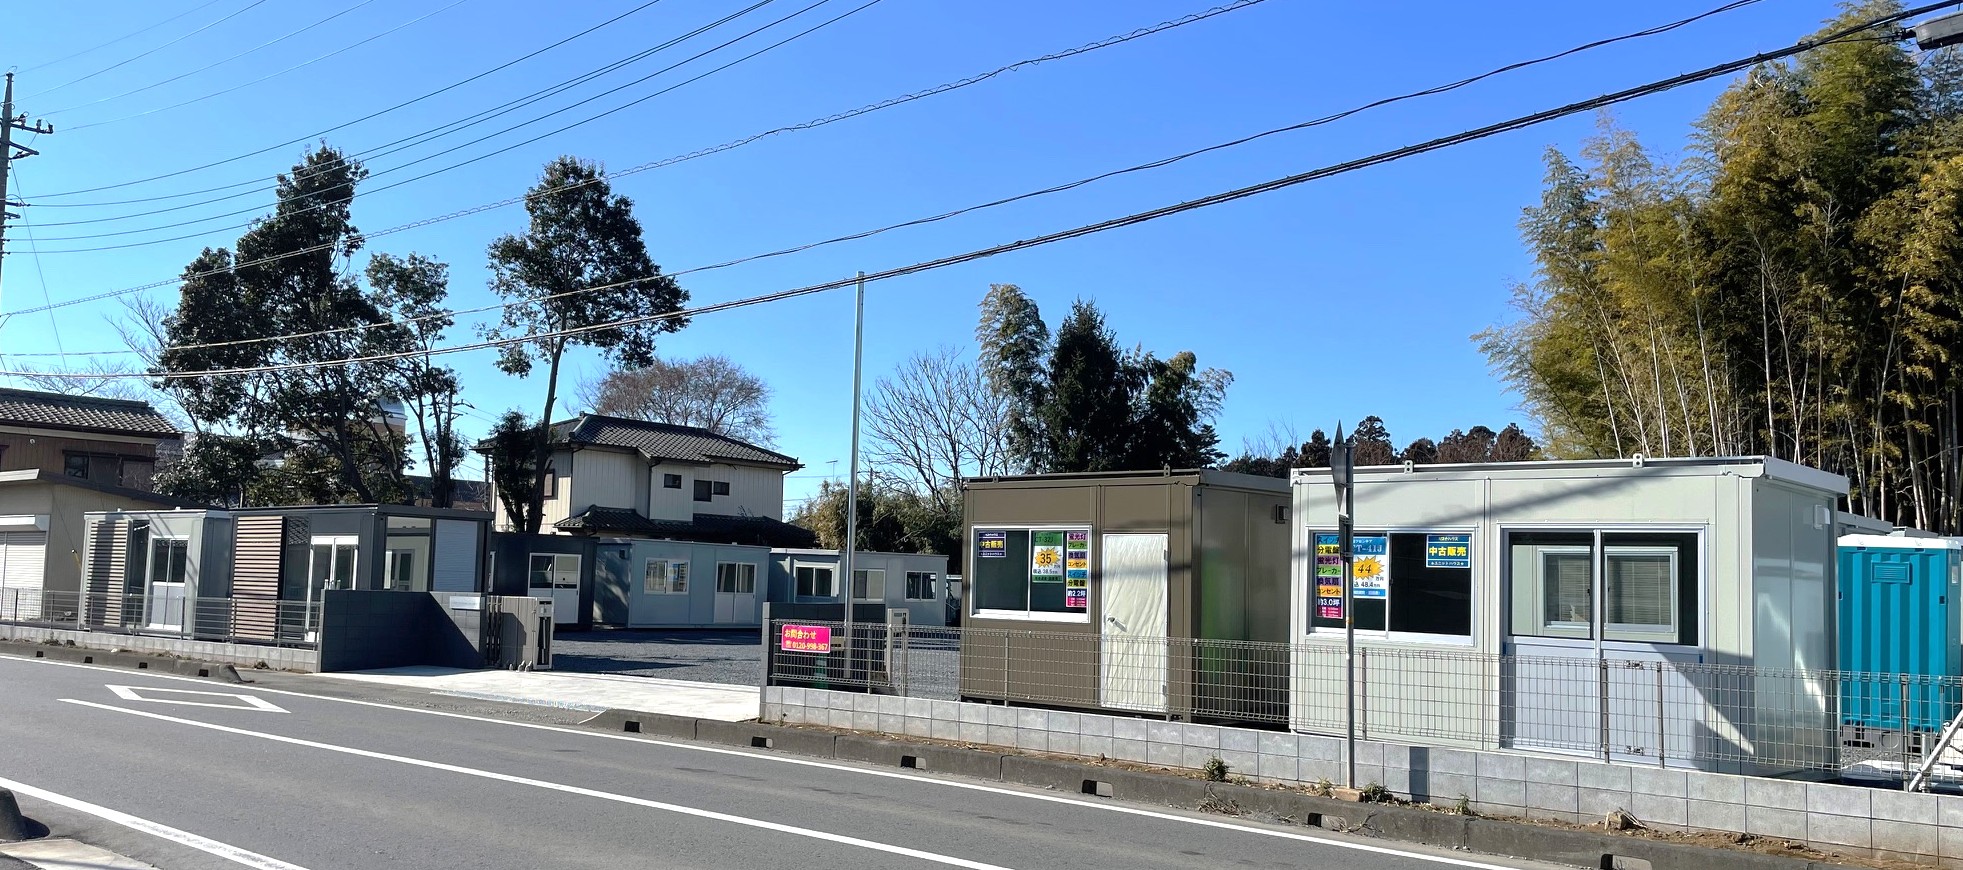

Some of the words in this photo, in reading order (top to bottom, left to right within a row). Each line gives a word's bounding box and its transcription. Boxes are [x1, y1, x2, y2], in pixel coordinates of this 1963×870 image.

[1317, 535, 1340, 544] スイッチ
[980, 540, 1004, 549] 中古販売
[1317, 546, 1340, 554] 分電盤
[1429, 546, 1467, 556] 中古販売
[1040, 553, 1052, 565] 35
[1317, 556, 1340, 564] 蛍光灯
[1358, 564, 1372, 573] 44
[1317, 577, 1340, 585] 換気扇
[784, 628, 817, 640] お問合わせ
